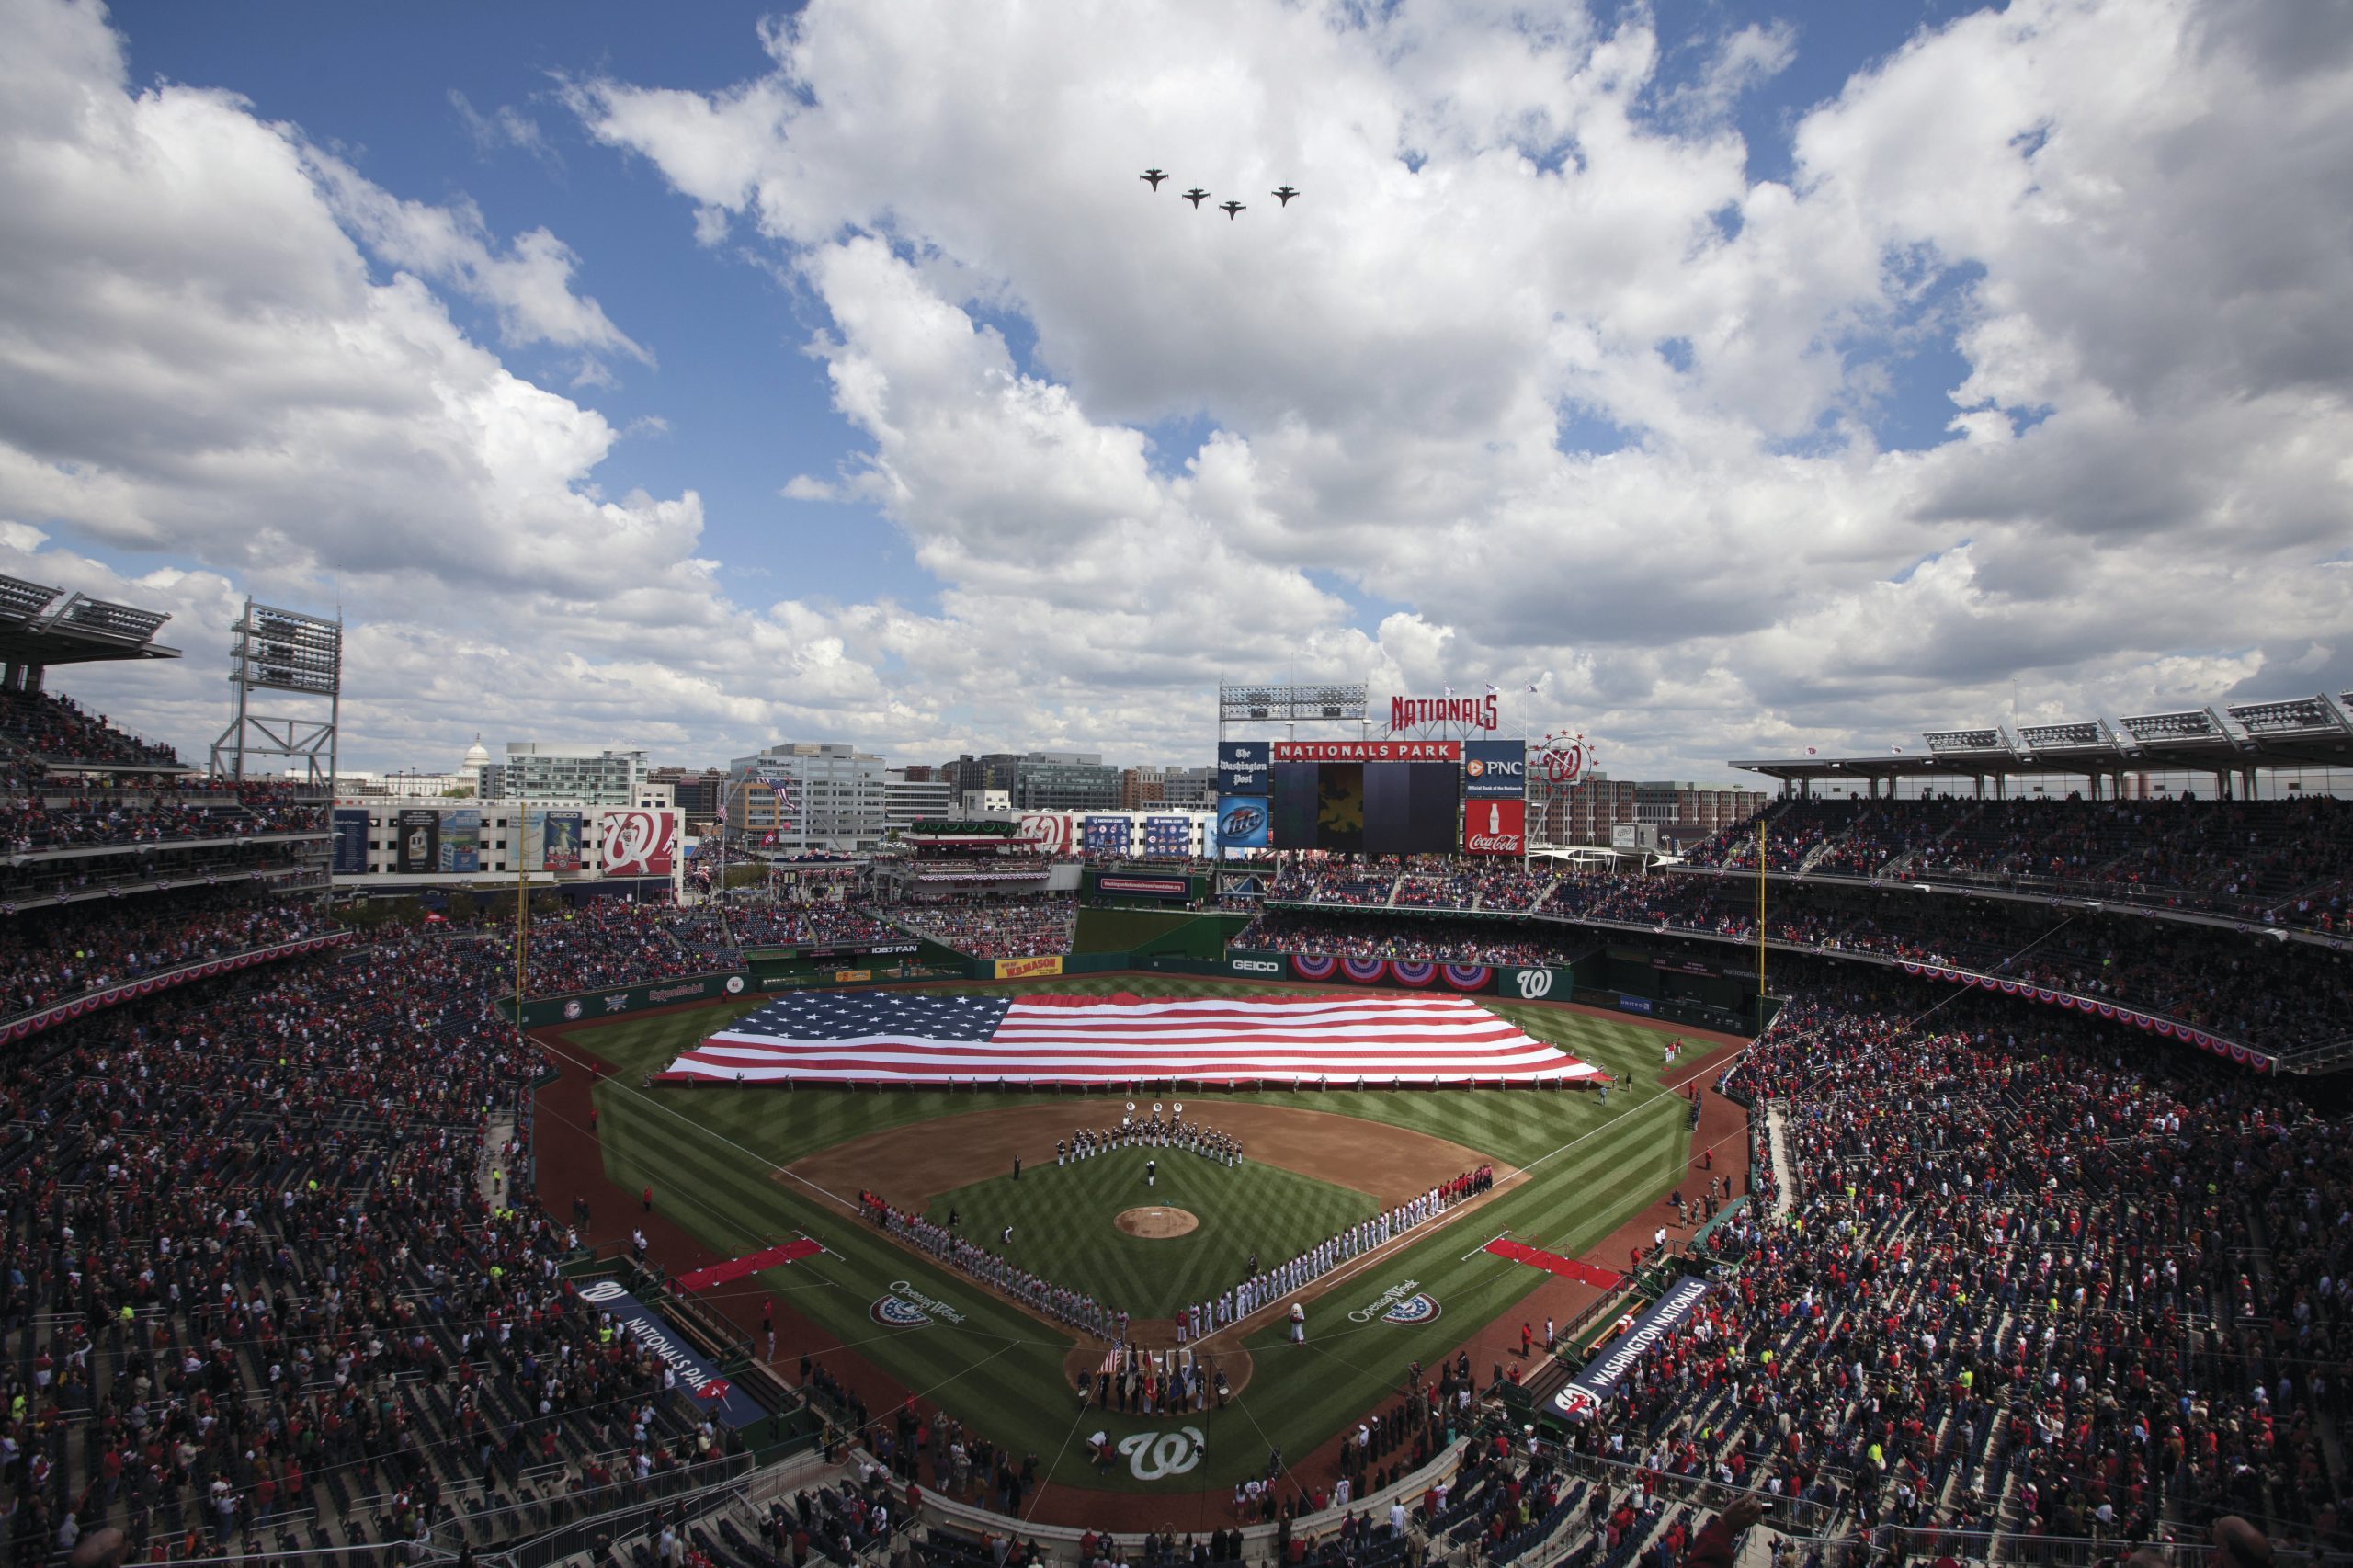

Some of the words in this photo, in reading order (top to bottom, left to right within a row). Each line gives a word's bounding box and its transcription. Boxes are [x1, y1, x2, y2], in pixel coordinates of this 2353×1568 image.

[1392, 695, 1497, 731] NATIONALS
[1235, 749, 1251, 759] The
[1280, 745, 1389, 756] NATIONALS
[1399, 745, 1449, 756] PARK
[1220, 762, 1267, 773] Washington
[1486, 761, 1523, 776] PNC
[1233, 774, 1253, 787] Post
[1469, 834, 1521, 851] Coca-Cola
[895, 945, 917, 953] FAN
[1233, 960, 1279, 972] GEICO
[649, 982, 705, 1002] ExxonMobil
[1620, 999, 1643, 1008] UNITED
[889, 1280, 937, 1309] Opening
[929, 1301, 968, 1324] Week
[1347, 1294, 1400, 1323] Opening
[1382, 1279, 1420, 1298] Week
[1588, 1324, 1664, 1387] WASHINGTON
[1651, 1281, 1707, 1327] NATIONALS
[625, 1316, 691, 1370] NATIONALS
